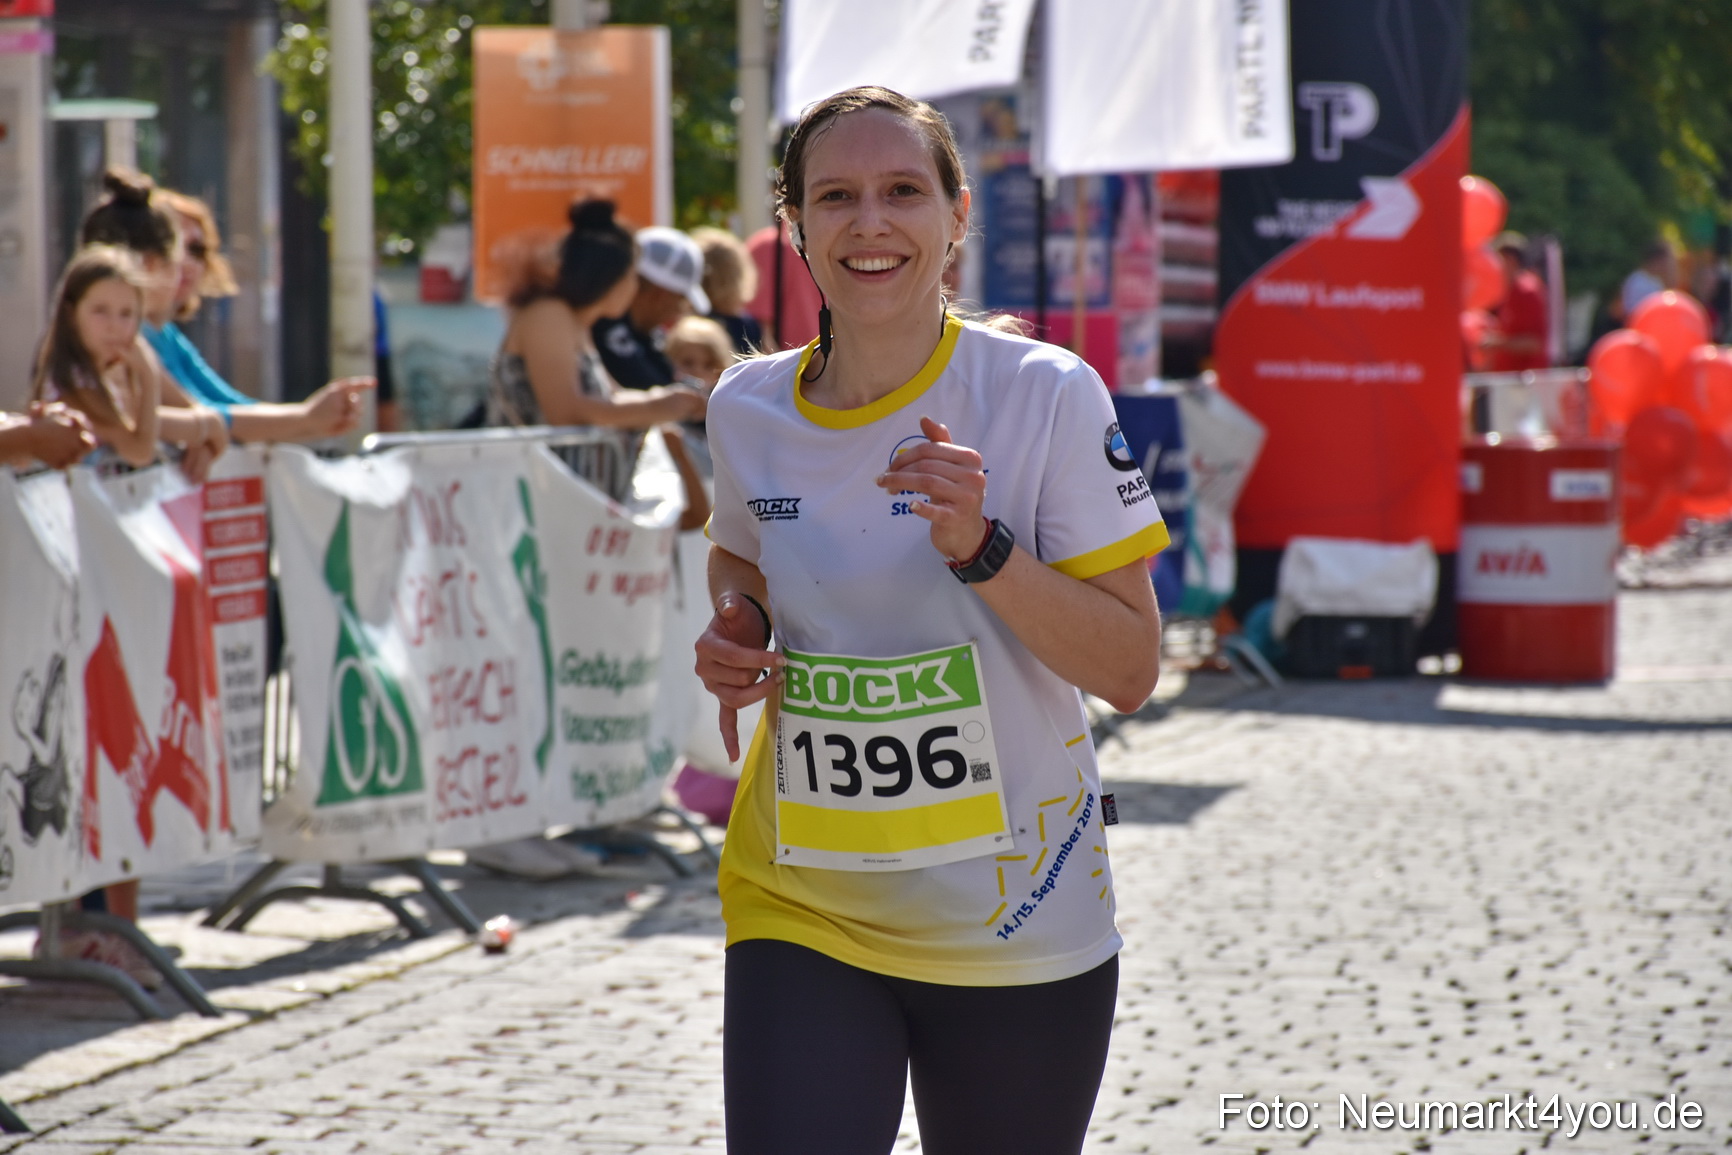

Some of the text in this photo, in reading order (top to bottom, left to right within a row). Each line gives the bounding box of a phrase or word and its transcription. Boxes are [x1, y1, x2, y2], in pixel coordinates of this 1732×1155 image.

[1254, 280, 1309, 305] BMW
[784, 656, 963, 714] BOCK
[793, 726, 967, 797] 1396
[996, 793, 1095, 940] 14./15. September 2019
